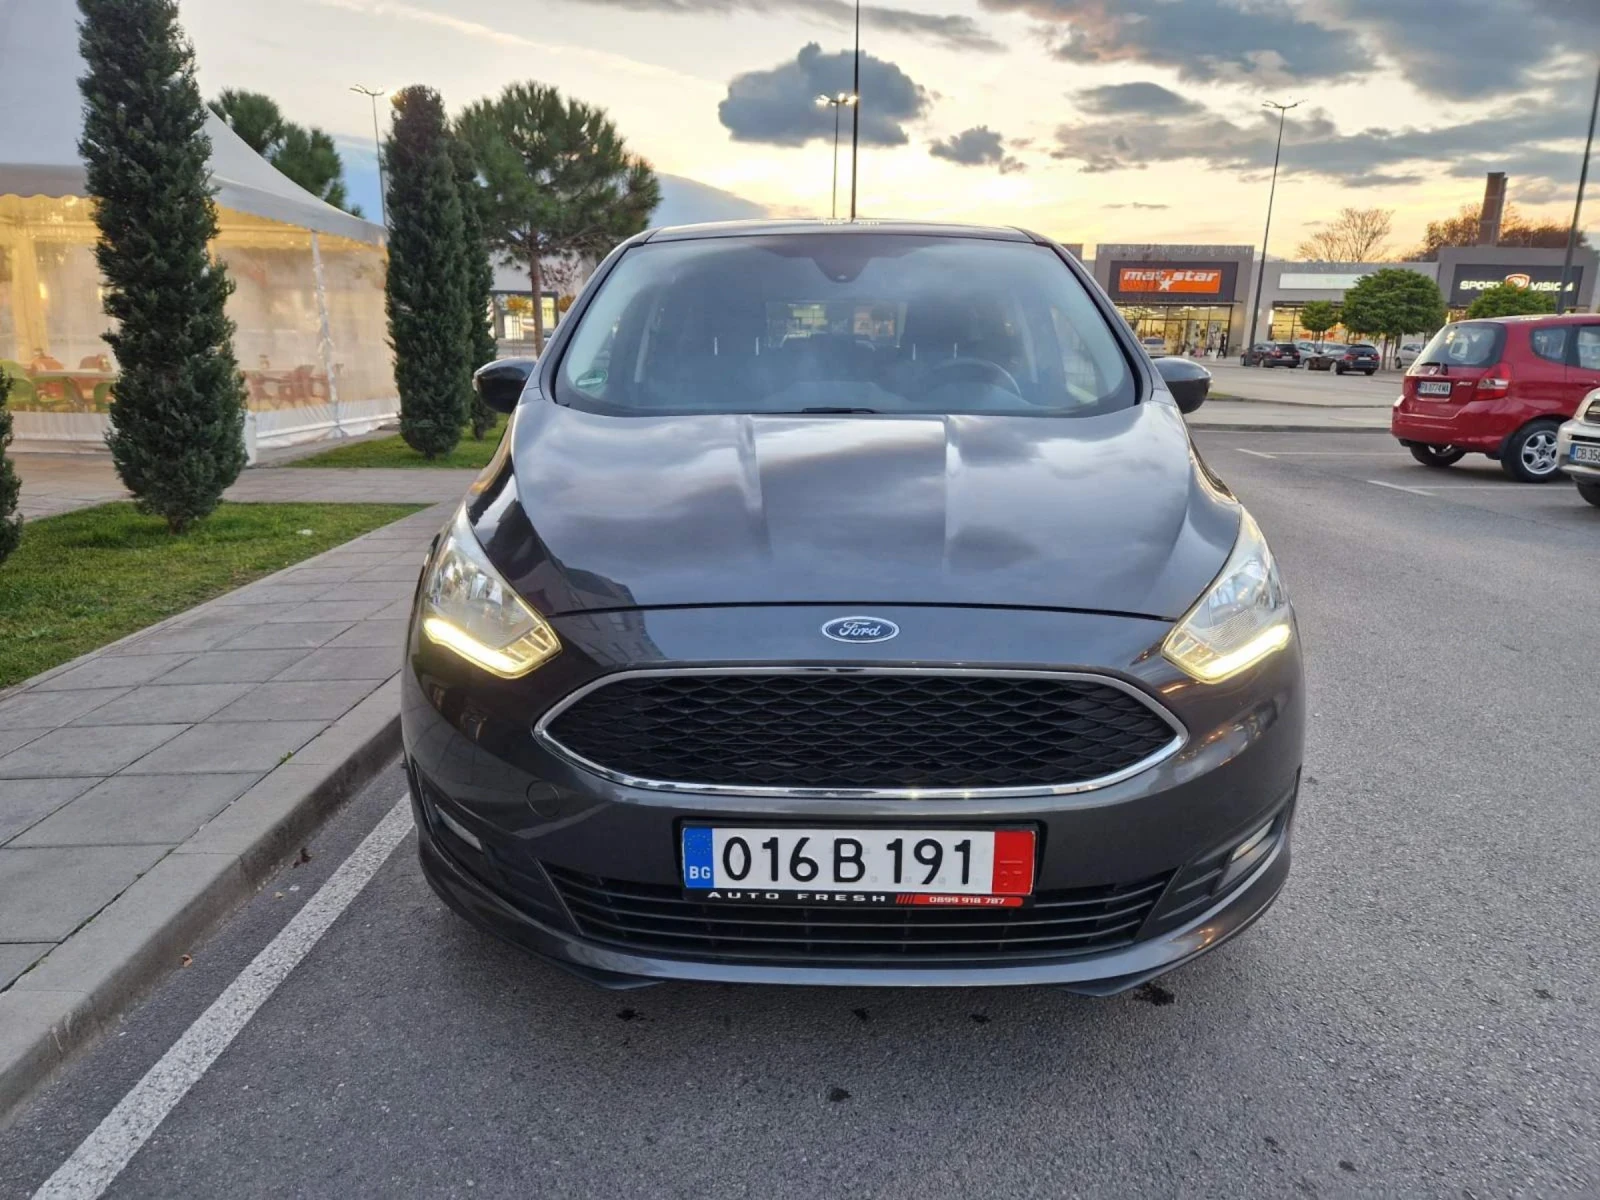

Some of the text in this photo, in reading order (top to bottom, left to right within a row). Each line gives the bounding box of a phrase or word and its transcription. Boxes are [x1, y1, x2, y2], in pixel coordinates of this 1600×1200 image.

[1172, 270, 1218, 282] star
[839, 621, 881, 636] Ford
[689, 866, 711, 879] BG
[707, 891, 886, 902] AUTO FRESH
[929, 896, 959, 904] 0899
[984, 897, 1005, 905] 787
